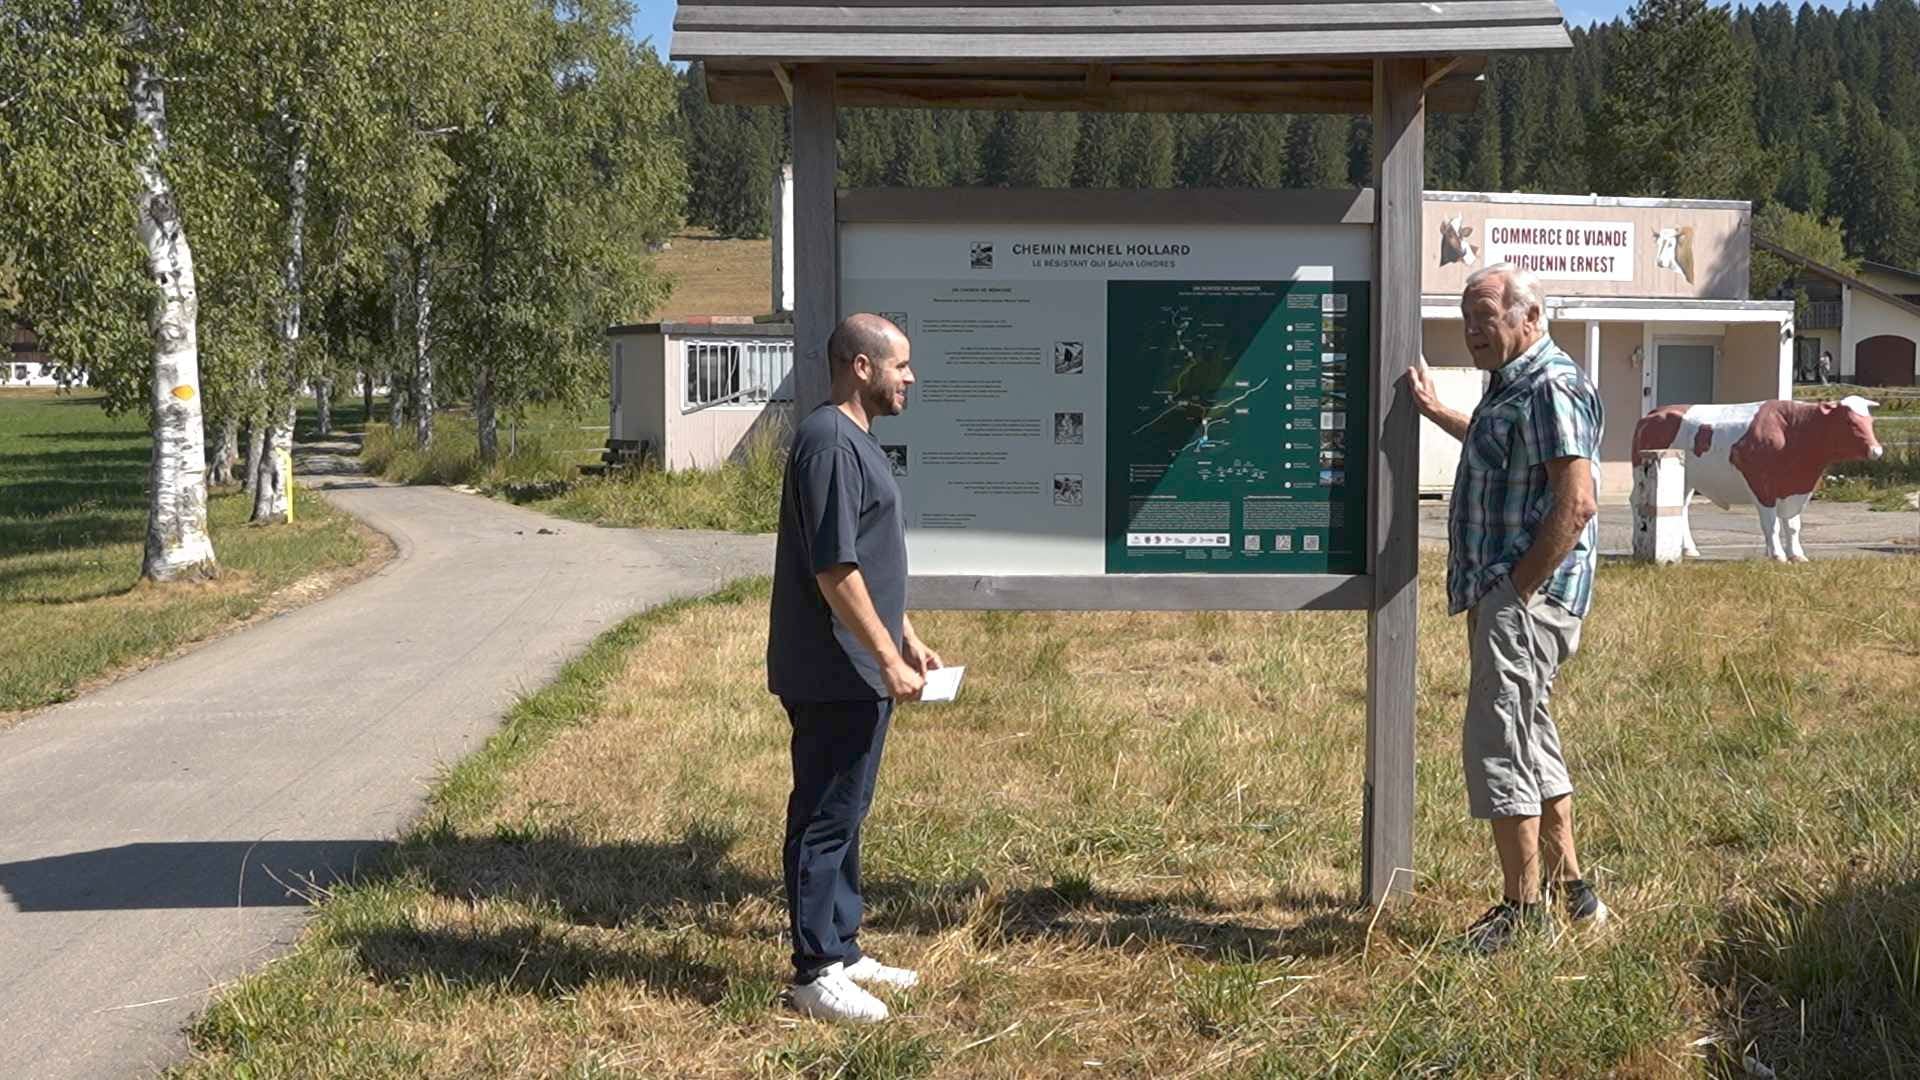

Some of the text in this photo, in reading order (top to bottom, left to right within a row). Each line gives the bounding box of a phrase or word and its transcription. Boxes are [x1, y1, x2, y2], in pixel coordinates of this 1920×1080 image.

[1492, 227, 1628, 247] COMMERCE DE VIANDE
[1012, 243, 1191, 256] CHEMIN MICHEL HOLLARD
[1570, 255, 1615, 273] ERNEST
